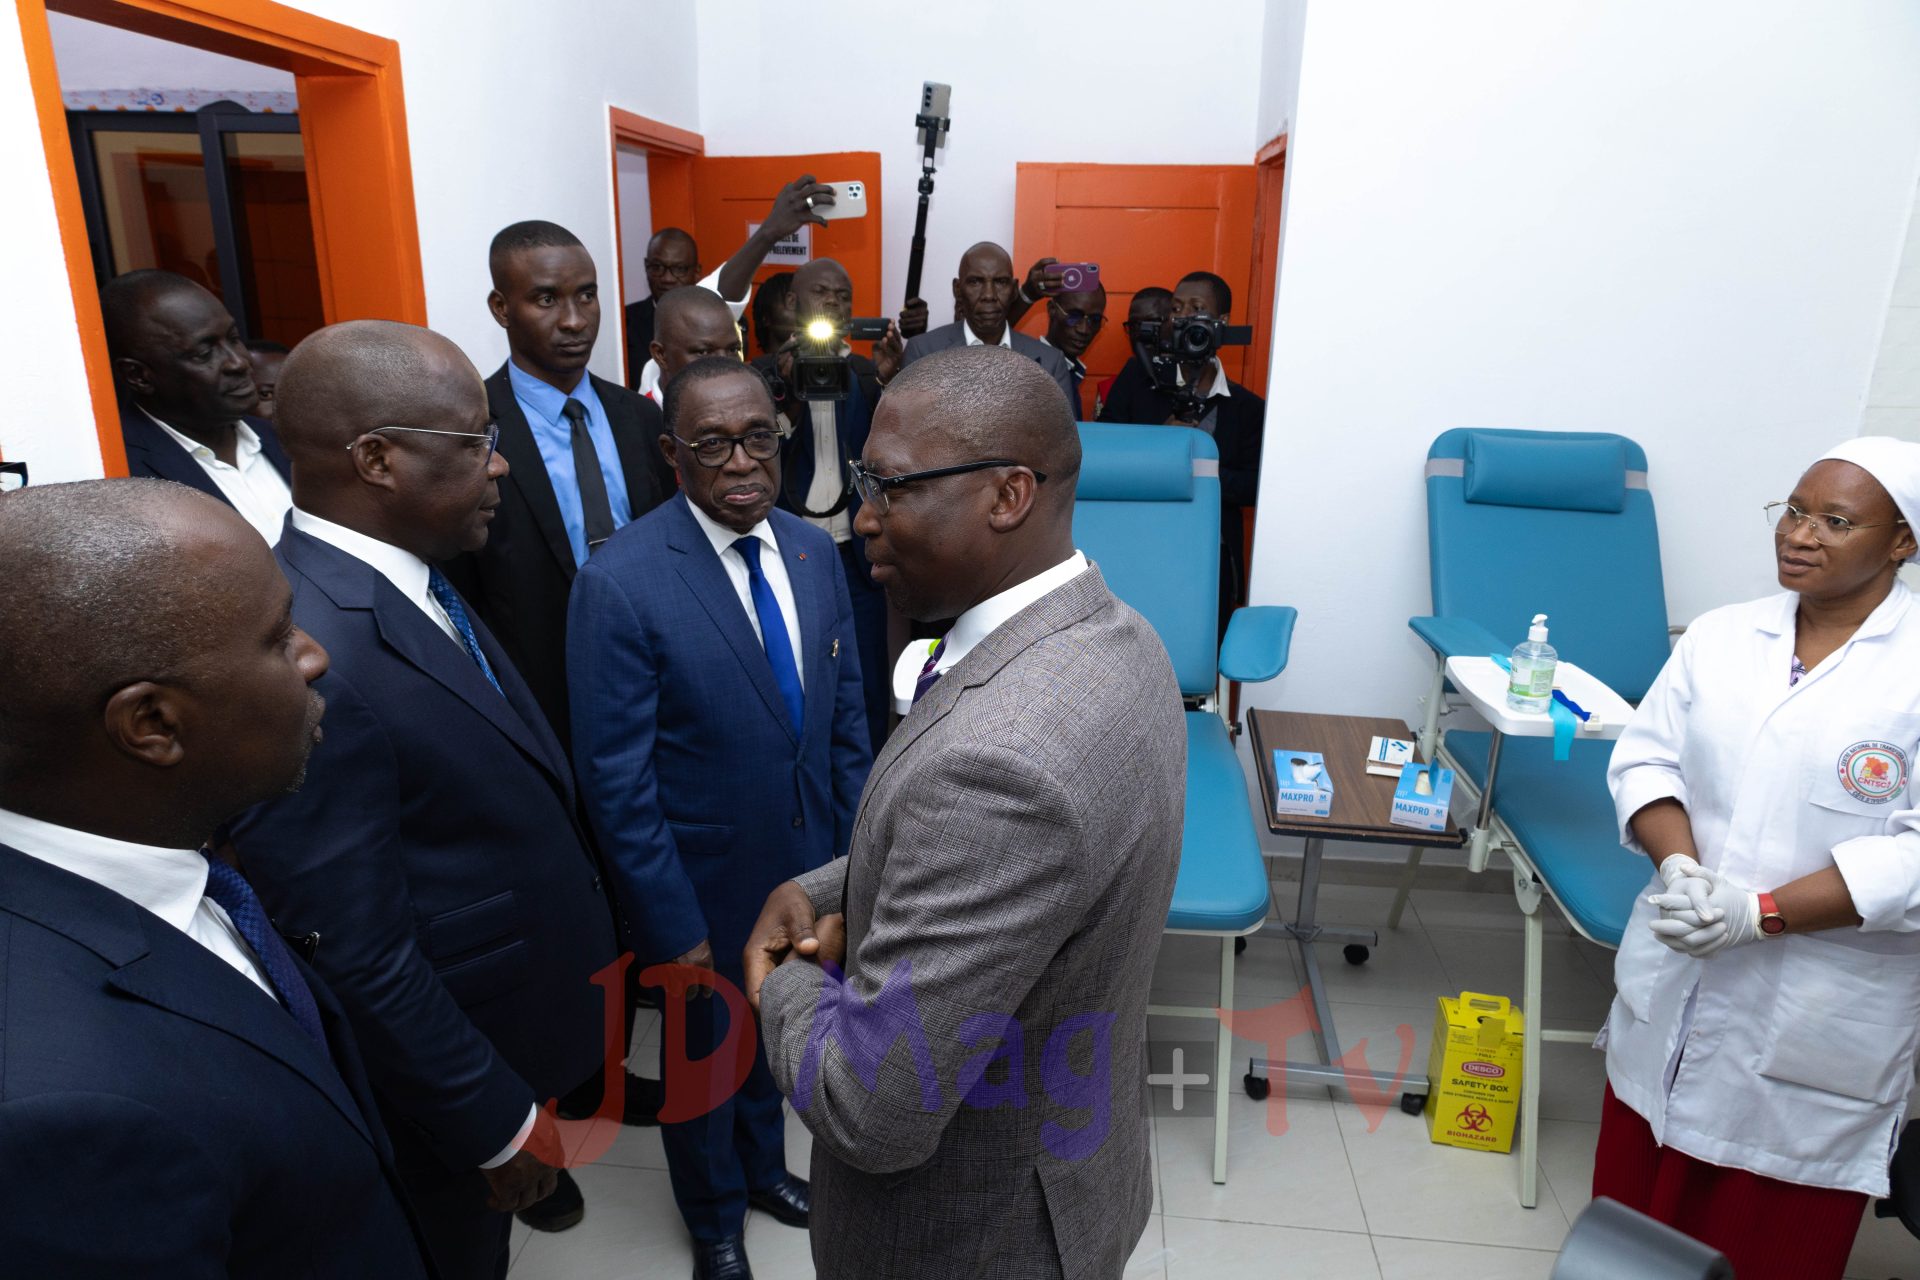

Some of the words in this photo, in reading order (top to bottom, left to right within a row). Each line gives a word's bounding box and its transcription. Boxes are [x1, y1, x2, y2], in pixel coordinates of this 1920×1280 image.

[792, 233, 799, 243] DE
[1280, 791, 1315, 803] MAXPRO
[1394, 801, 1431, 816] MAXPRO
[1467, 1064, 1500, 1075] DESCO
[1451, 1078, 1489, 1090] SAFETY
[1489, 1084, 1509, 1093] BOX
[1446, 1130, 1497, 1142] BIOHAZARD
